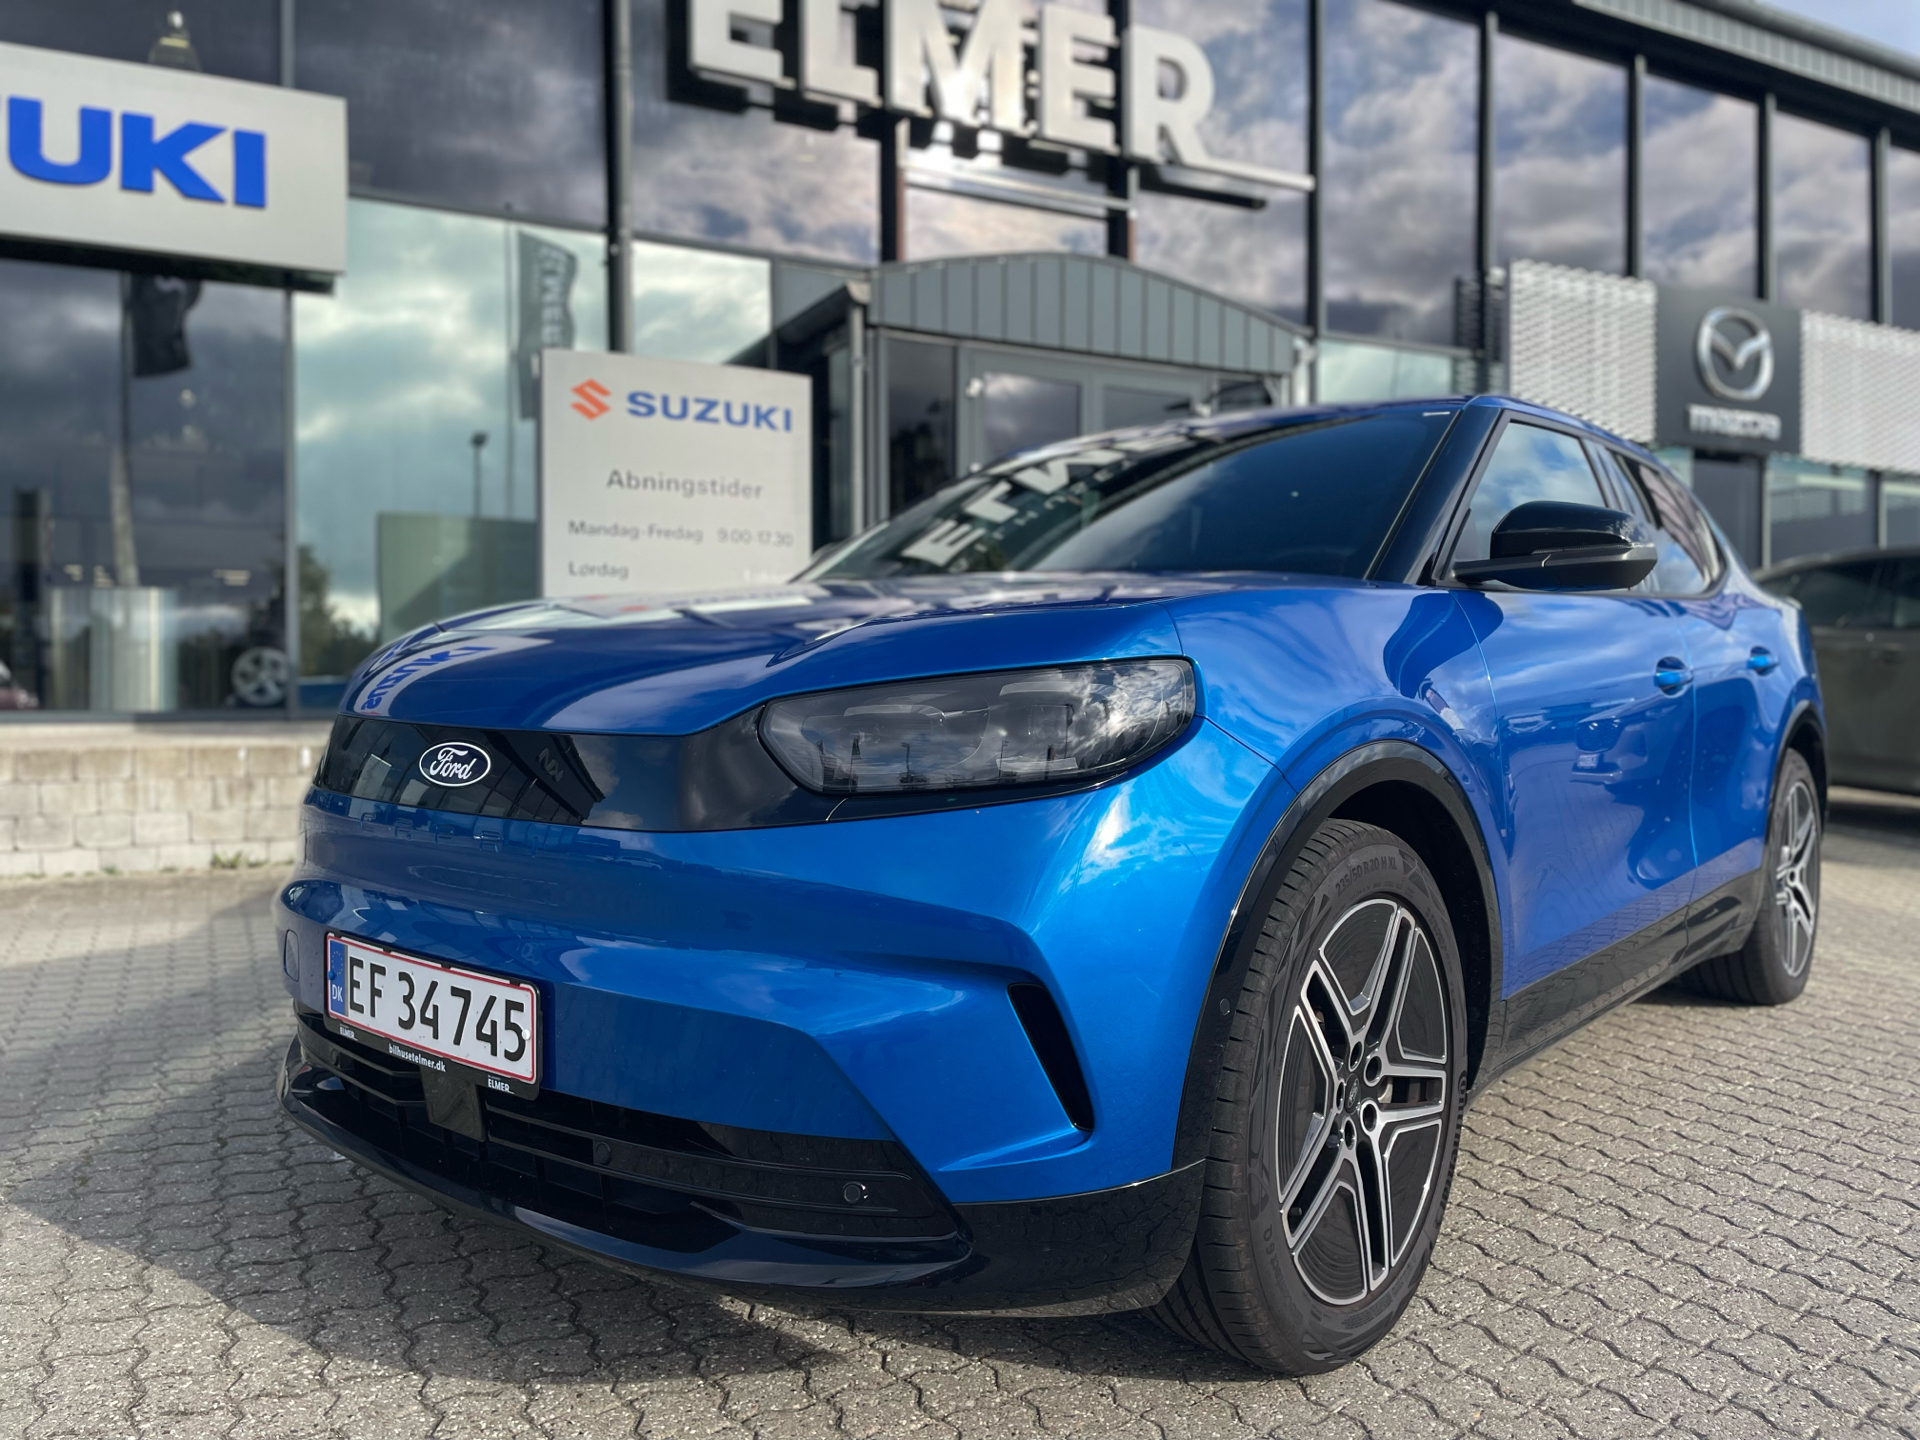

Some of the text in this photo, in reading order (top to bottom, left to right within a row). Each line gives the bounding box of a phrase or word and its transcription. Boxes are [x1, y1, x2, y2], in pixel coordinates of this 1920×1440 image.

[688, 0, 1314, 190] ELMER
[7, 95, 267, 209] UKI
[626, 390, 793, 433] SUZUKI
[429, 747, 477, 780] Ford
[360, 811, 538, 858] CAPRI
[332, 983, 343, 1002] DK
[349, 956, 386, 1018] EF
[388, 1043, 446, 1072] bilhusetelmer.dk
[487, 1078, 515, 1095] ELMER
